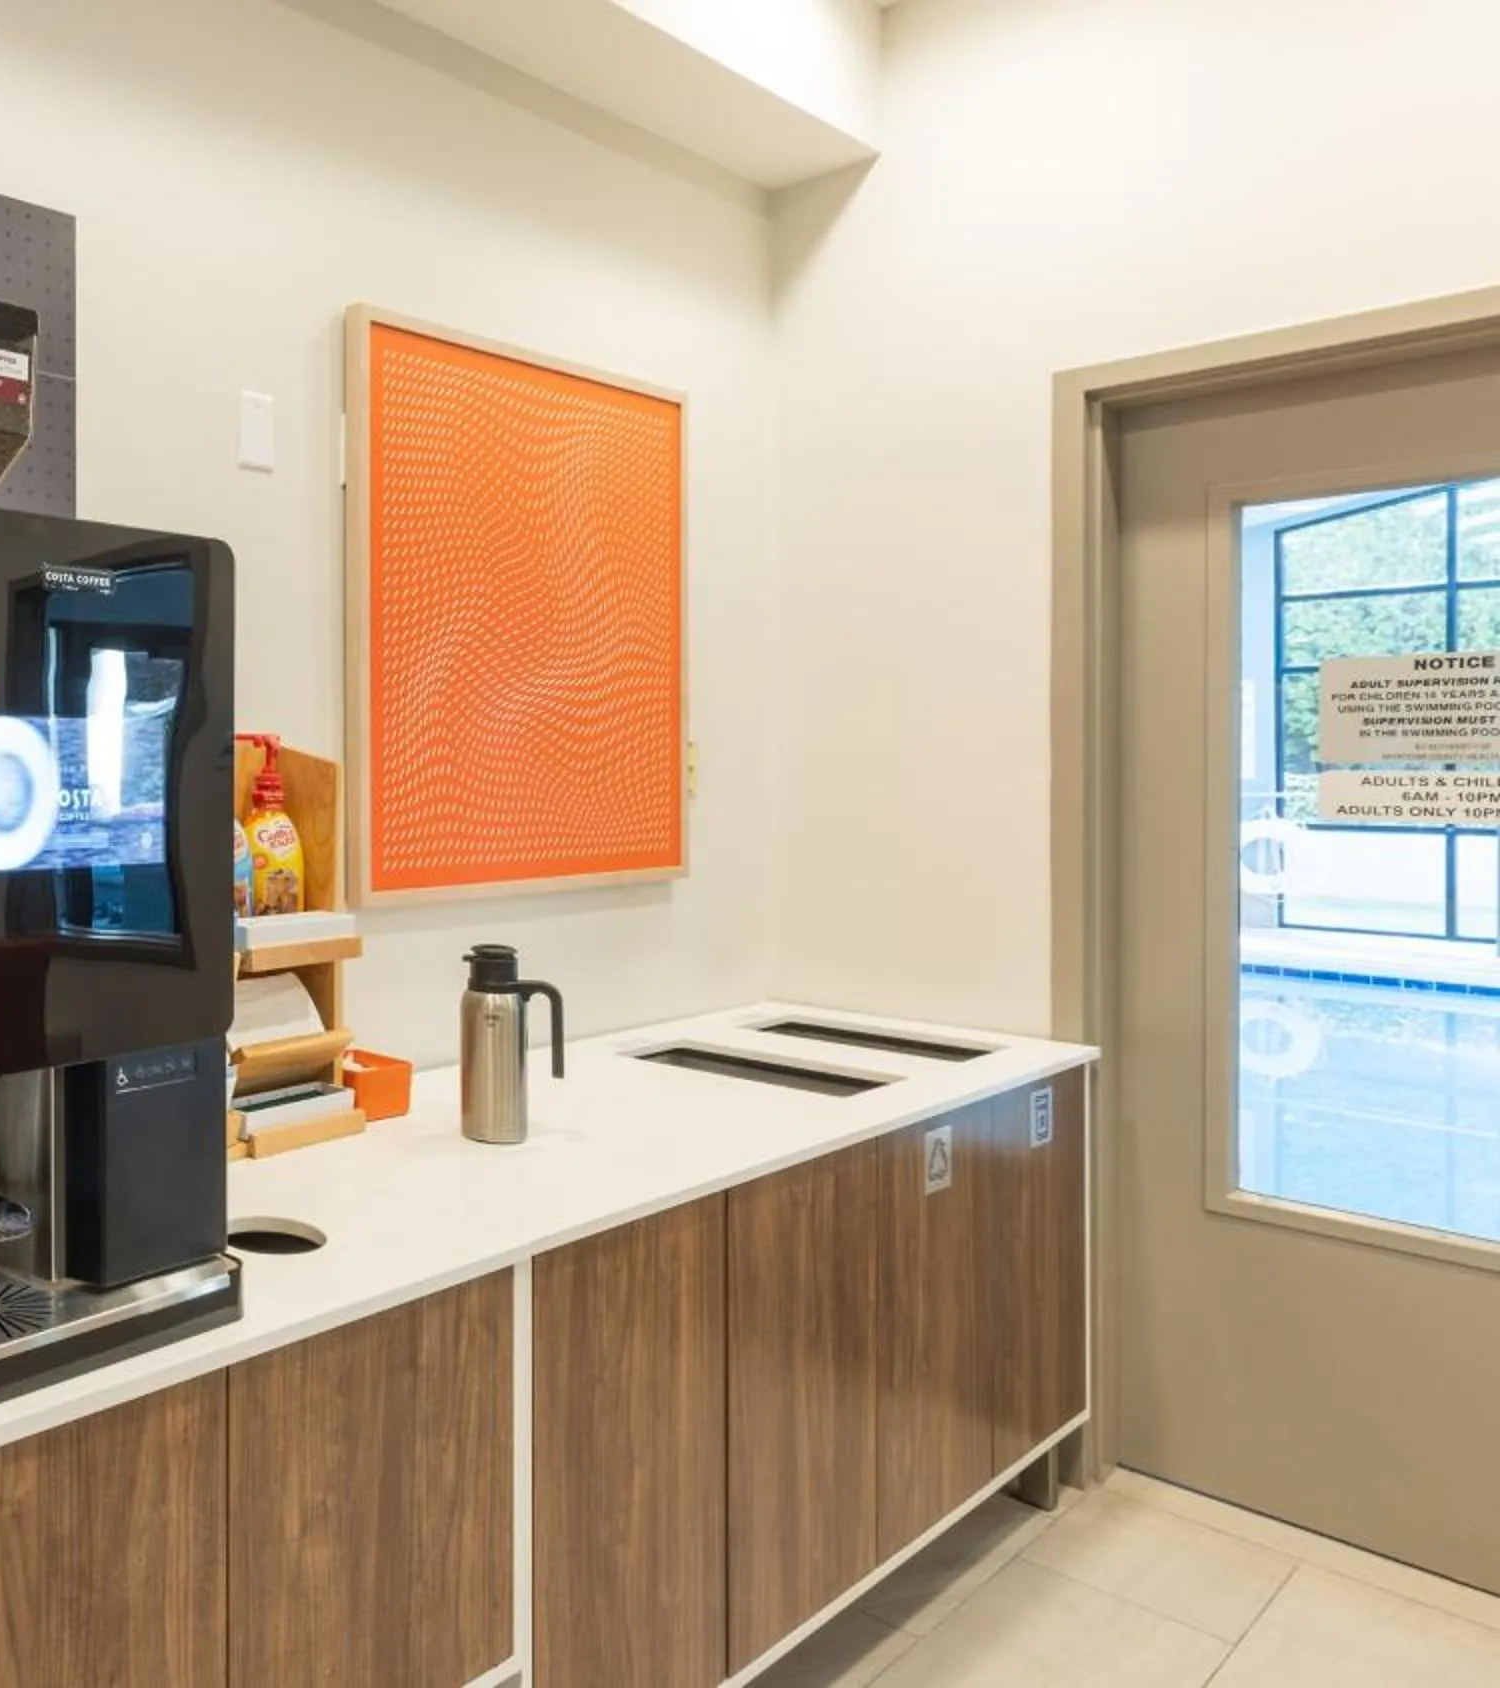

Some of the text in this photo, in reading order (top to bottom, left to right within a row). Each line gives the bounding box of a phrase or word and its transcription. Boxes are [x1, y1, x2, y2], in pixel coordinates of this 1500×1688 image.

[1414, 655, 1495, 671] NOTICE
[1350, 679, 1392, 689] ADULT
[1397, 676, 1489, 688] SUPERVISION
[1475, 701, 1500, 711] POO
[1456, 715, 1497, 725] MUST
[1471, 727, 1500, 737] POO
[1361, 775, 1429, 787] ADULTS
[1453, 776, 1500, 788] CHIL
[1336, 804, 1404, 817] ADULTS
[1409, 806, 1457, 817] ONLY
